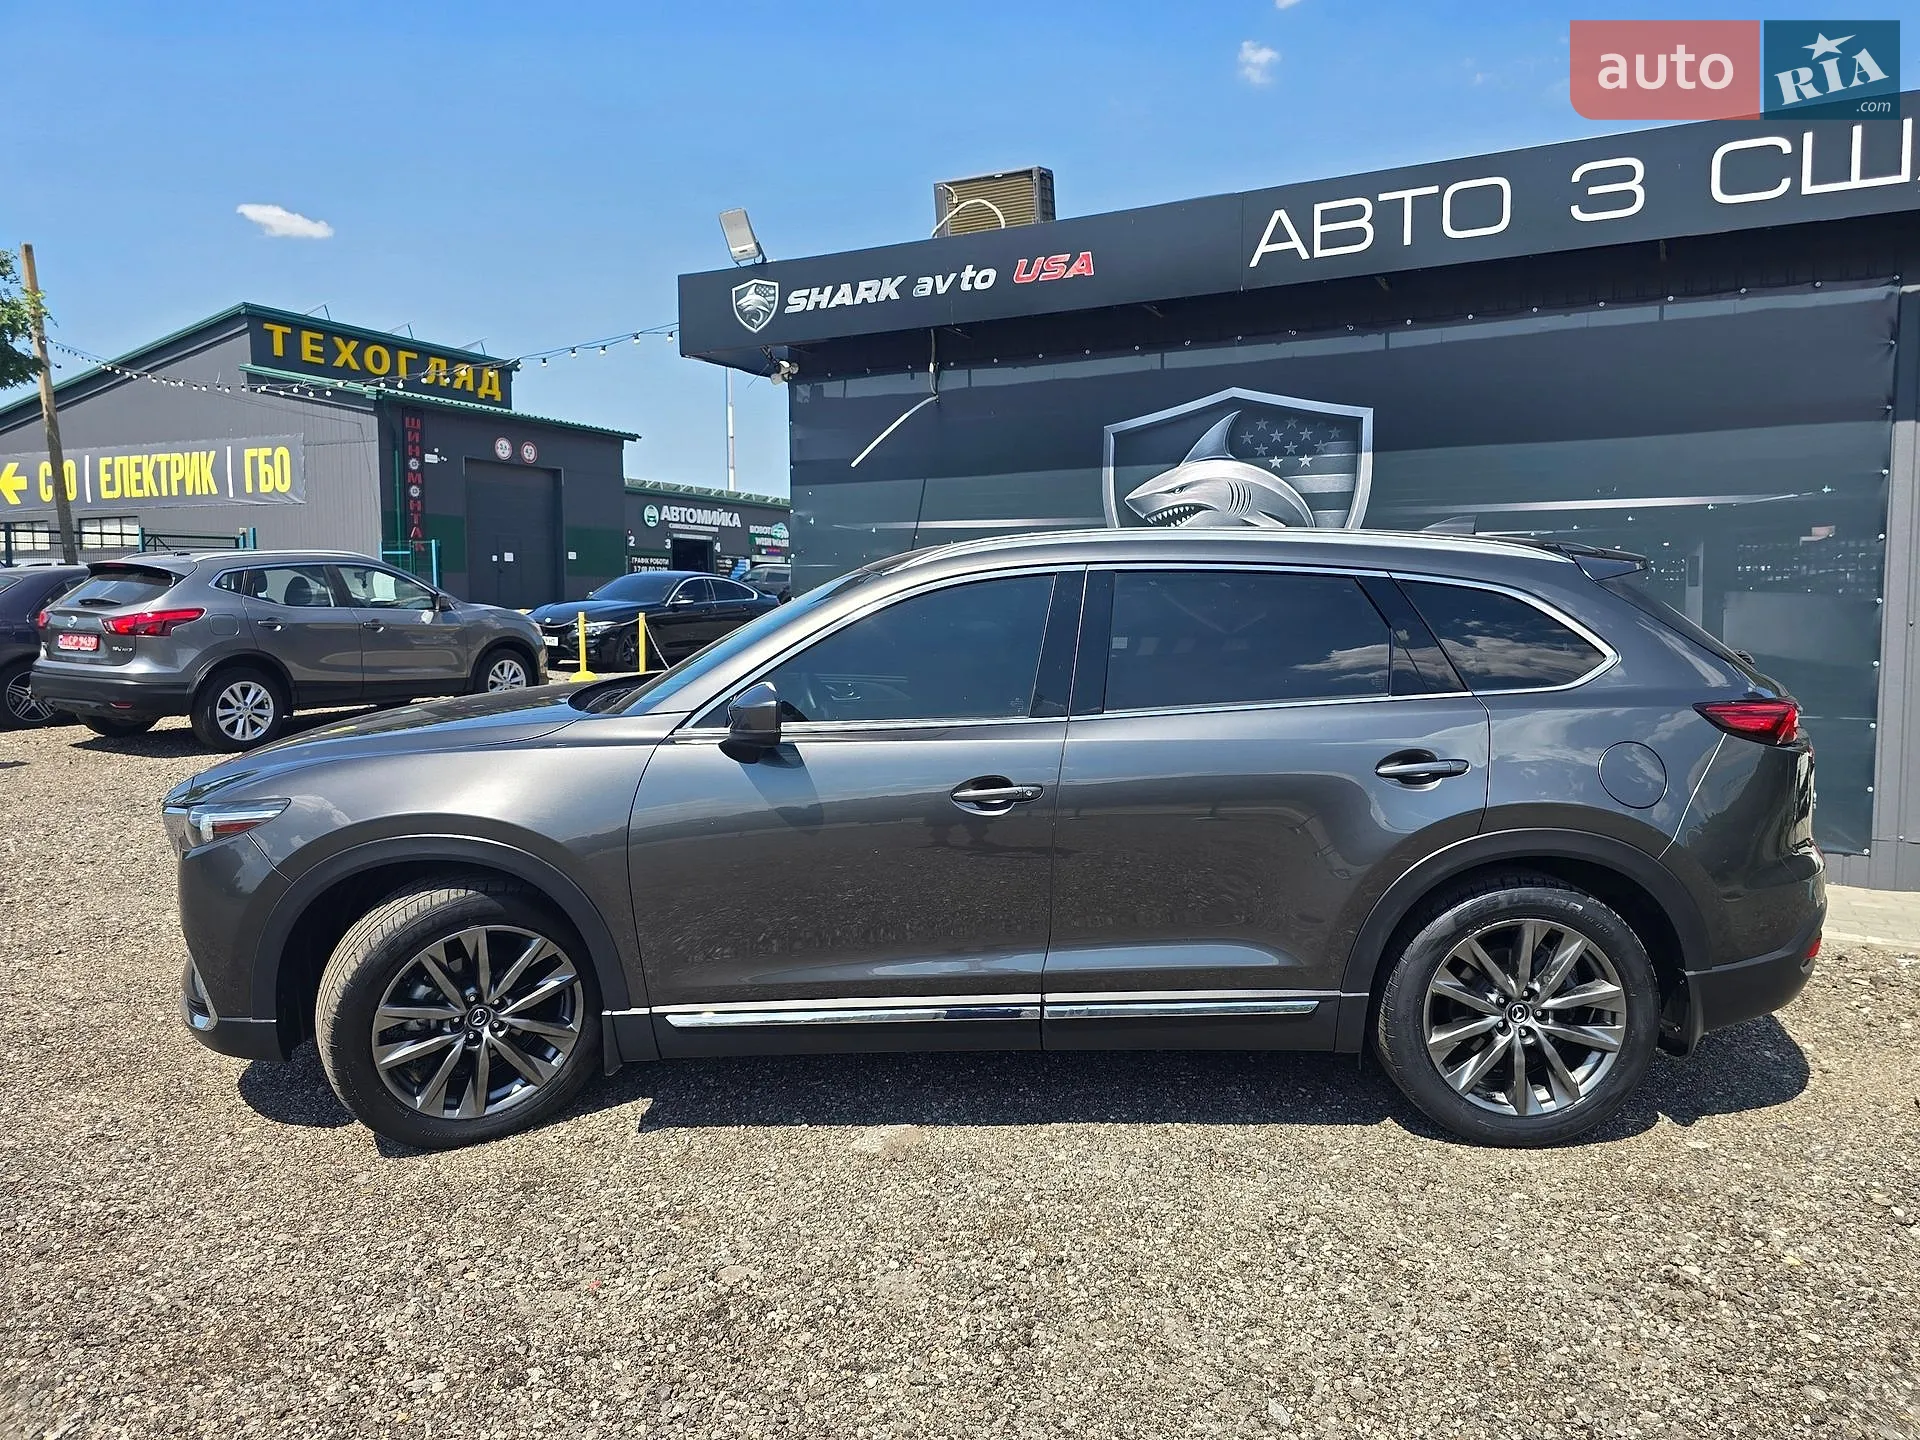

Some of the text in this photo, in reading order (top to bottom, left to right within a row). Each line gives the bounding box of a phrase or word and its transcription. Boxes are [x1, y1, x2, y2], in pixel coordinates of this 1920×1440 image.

[1249, 176, 1512, 268] АВТО
[1709, 117, 1920, 205] СШ
[784, 275, 907, 315] SHARK
[1012, 251, 1095, 284] USA
[262, 321, 503, 403] ТЕХОГЛЯД
[38, 446, 292, 503] СО ЕЛЕКТРИК ГБО
[660, 505, 742, 528] АВТОМИЙКА
[628, 535, 636, 547] 2
[665, 538, 672, 550] 3
[714, 541, 721, 553] 4
